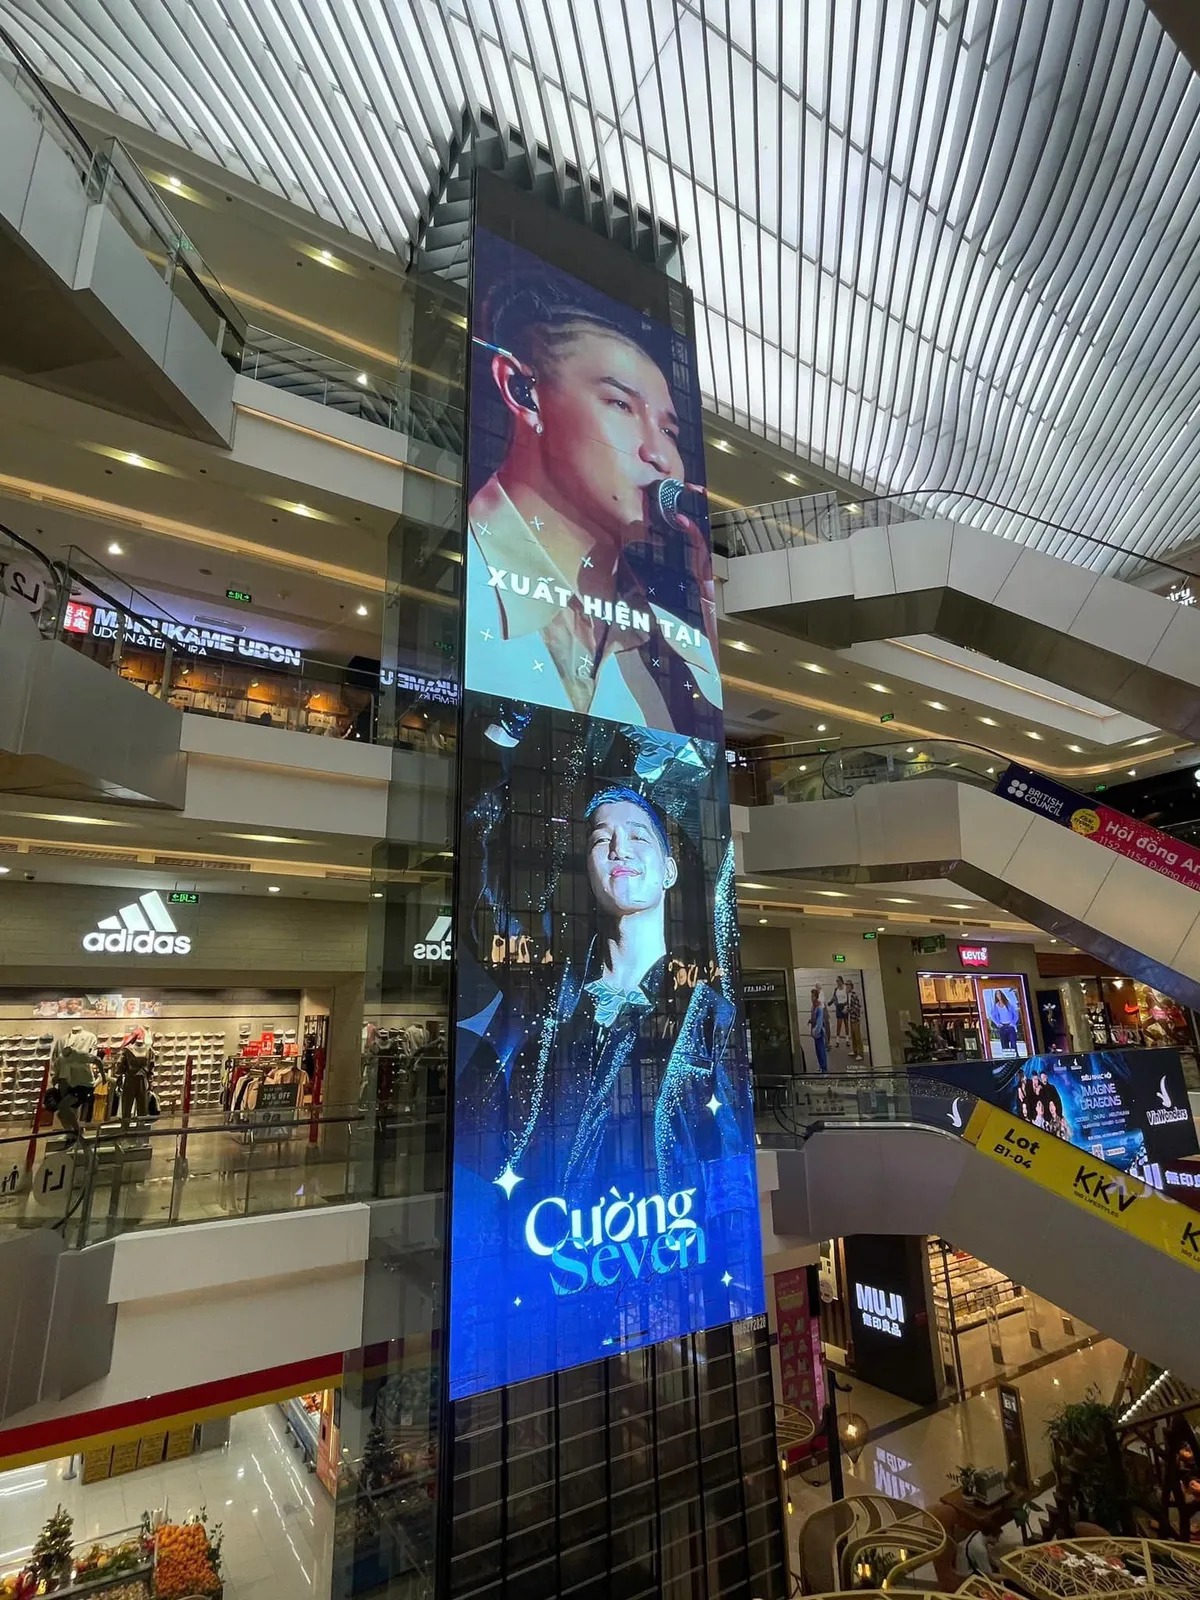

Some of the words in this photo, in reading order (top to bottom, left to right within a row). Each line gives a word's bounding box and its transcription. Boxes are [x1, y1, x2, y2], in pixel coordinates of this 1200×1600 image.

[486, 565, 574, 608] XUẤT
[583, 595, 650, 632] HIỆN
[658, 618, 701, 648] TẠI
[238, 638, 301, 666] UDON
[1024, 794, 1061, 817] COUNCIL
[1028, 787, 1064, 809] BRITISH
[1105, 821, 1134, 842] Hội
[1136, 836, 1179, 866] đồng
[82, 928, 192, 955] adidas
[1080, 1083, 1117, 1098] IMAGINE
[1080, 1095, 1122, 1111] DRAGONS
[1146, 1107, 1189, 1126] VinWonders
[1004, 1128, 1040, 1155] Lot
[993, 1143, 1032, 1169] B1-04
[525, 1185, 697, 1256] Cường
[549, 1227, 706, 1296] Seven
[855, 1282, 905, 1323] MUJI
[862, 1312, 902, 1338] 無印良品
